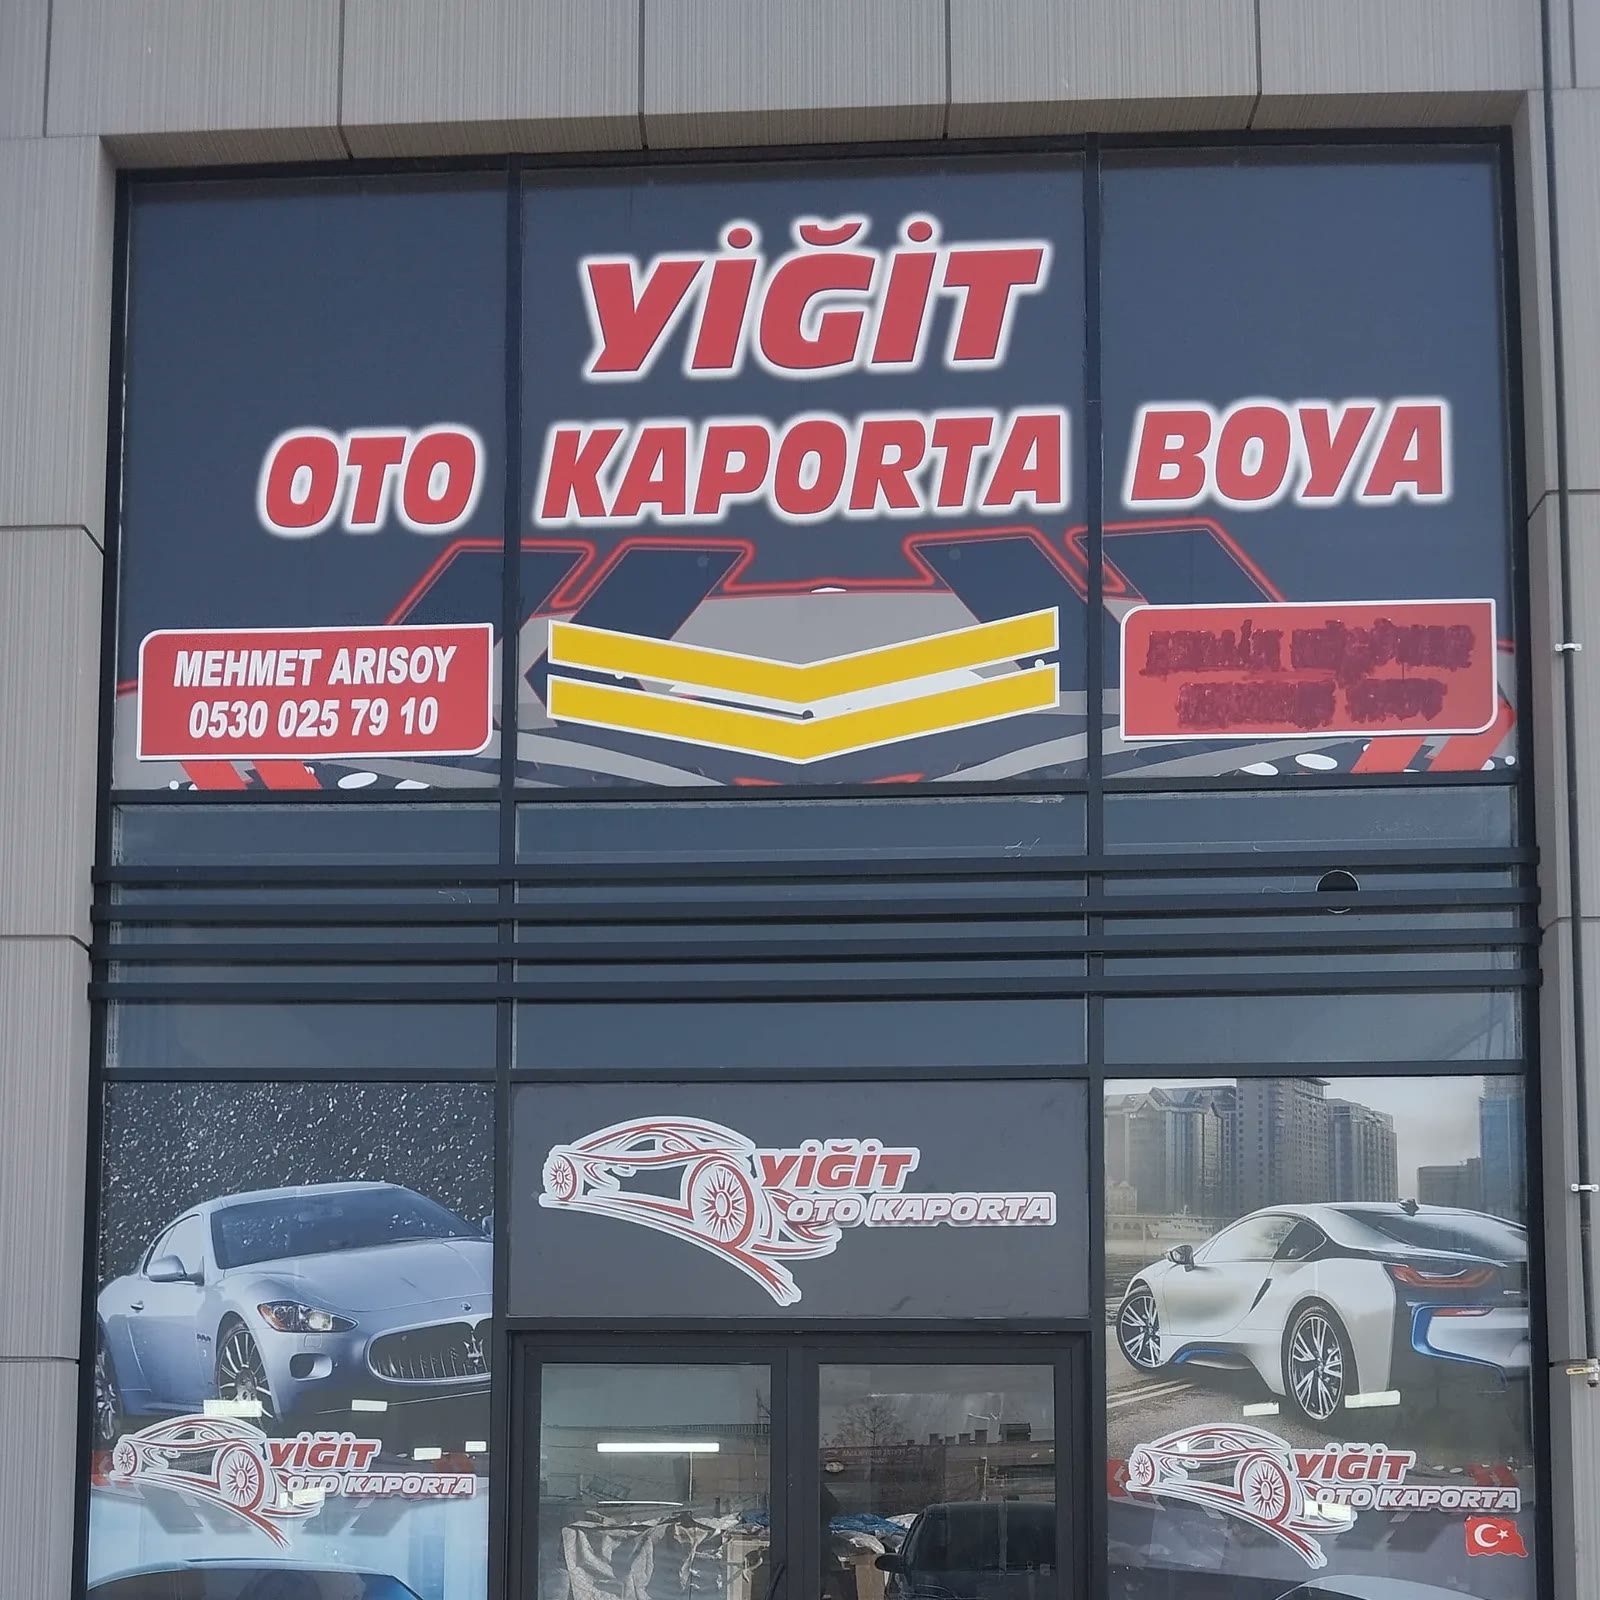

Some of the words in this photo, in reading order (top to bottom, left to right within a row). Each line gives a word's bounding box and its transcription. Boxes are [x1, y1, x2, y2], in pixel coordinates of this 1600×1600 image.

[582, 217, 1049, 376] YİĞİT
[261, 428, 481, 531] OTO
[538, 411, 1065, 523] KAPORTA
[1127, 401, 1447, 504] BOYA
[172, 648, 323, 688] MEHMET
[327, 645, 458, 686] ARISOY
[188, 700, 269, 739] 0530
[277, 699, 340, 738] 025
[350, 697, 390, 737] 79
[399, 696, 439, 735] 10
[758, 1144, 915, 1188] YİĞİT
[785, 1197, 860, 1223] OTO
[870, 1195, 1053, 1223] KAPORTA
[268, 1435, 378, 1468] YİĞİT
[1293, 1446, 1412, 1480] YİĞİT
[286, 1474, 340, 1494] OTO
[344, 1474, 475, 1496] KAPORTA
[1315, 1486, 1373, 1506] OTO
[1379, 1486, 1519, 1510] KAPORTA
